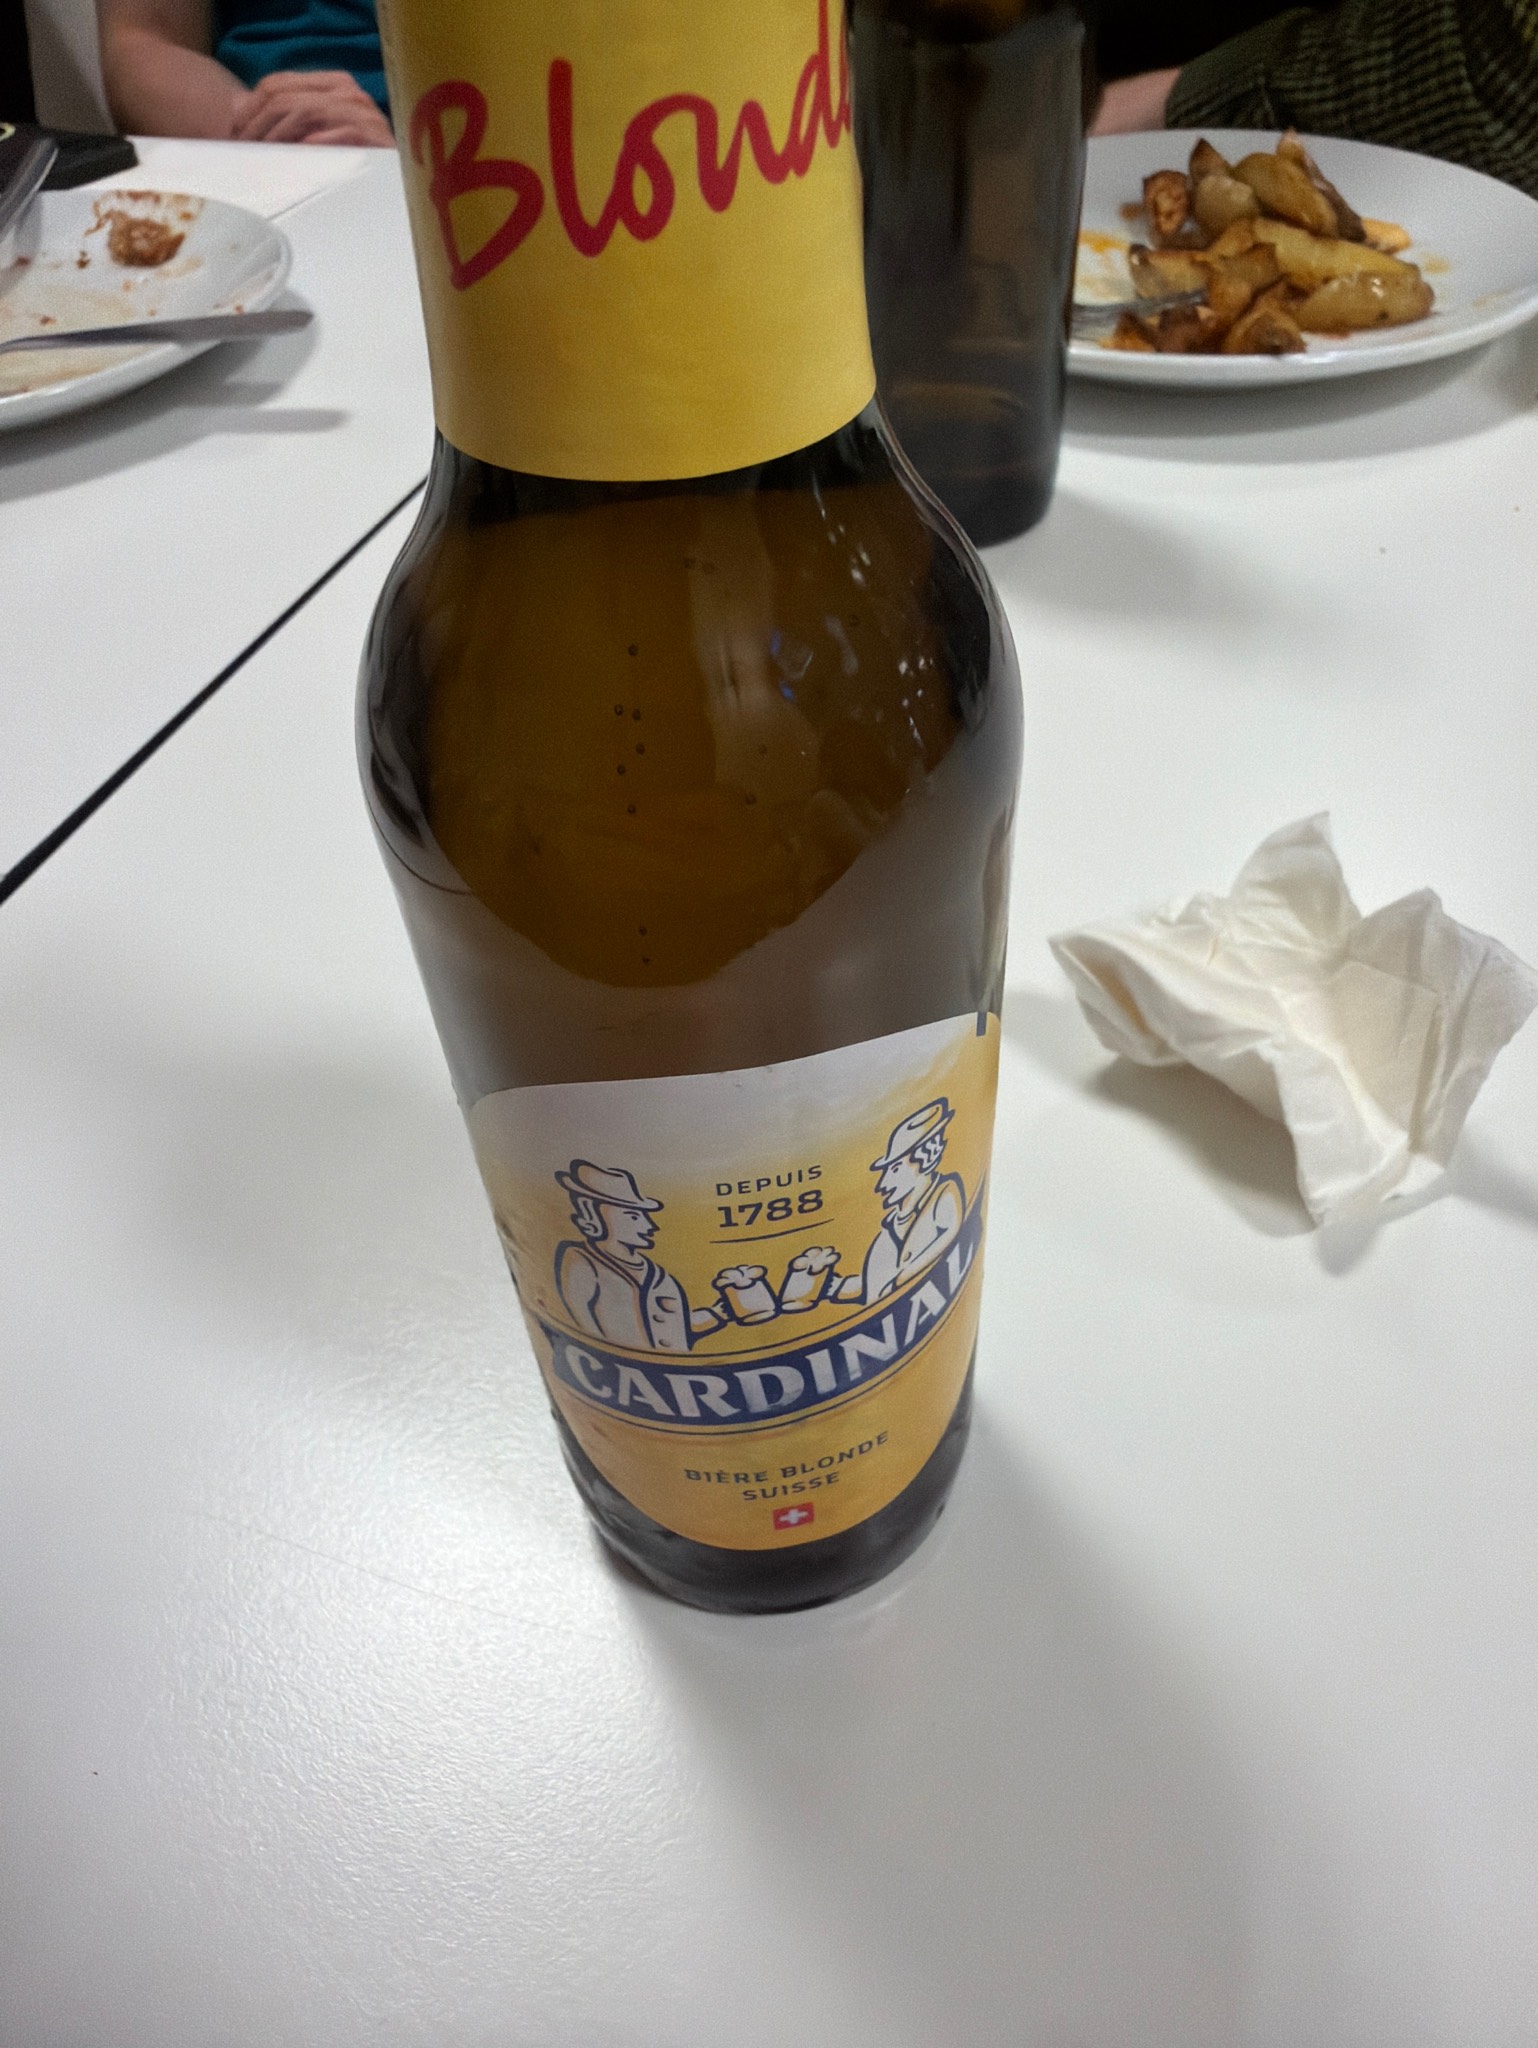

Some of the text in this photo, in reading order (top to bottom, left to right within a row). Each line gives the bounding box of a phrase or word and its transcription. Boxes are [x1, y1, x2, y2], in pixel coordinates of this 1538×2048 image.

[716, 1166, 823, 1195] DEPUIS
[718, 1190, 823, 1228] 1788
[567, 1241, 973, 1418] CARDINAL
[685, 1431, 888, 1483] BIÈRE BLONDE
[743, 1472, 840, 1501] SUISSE
